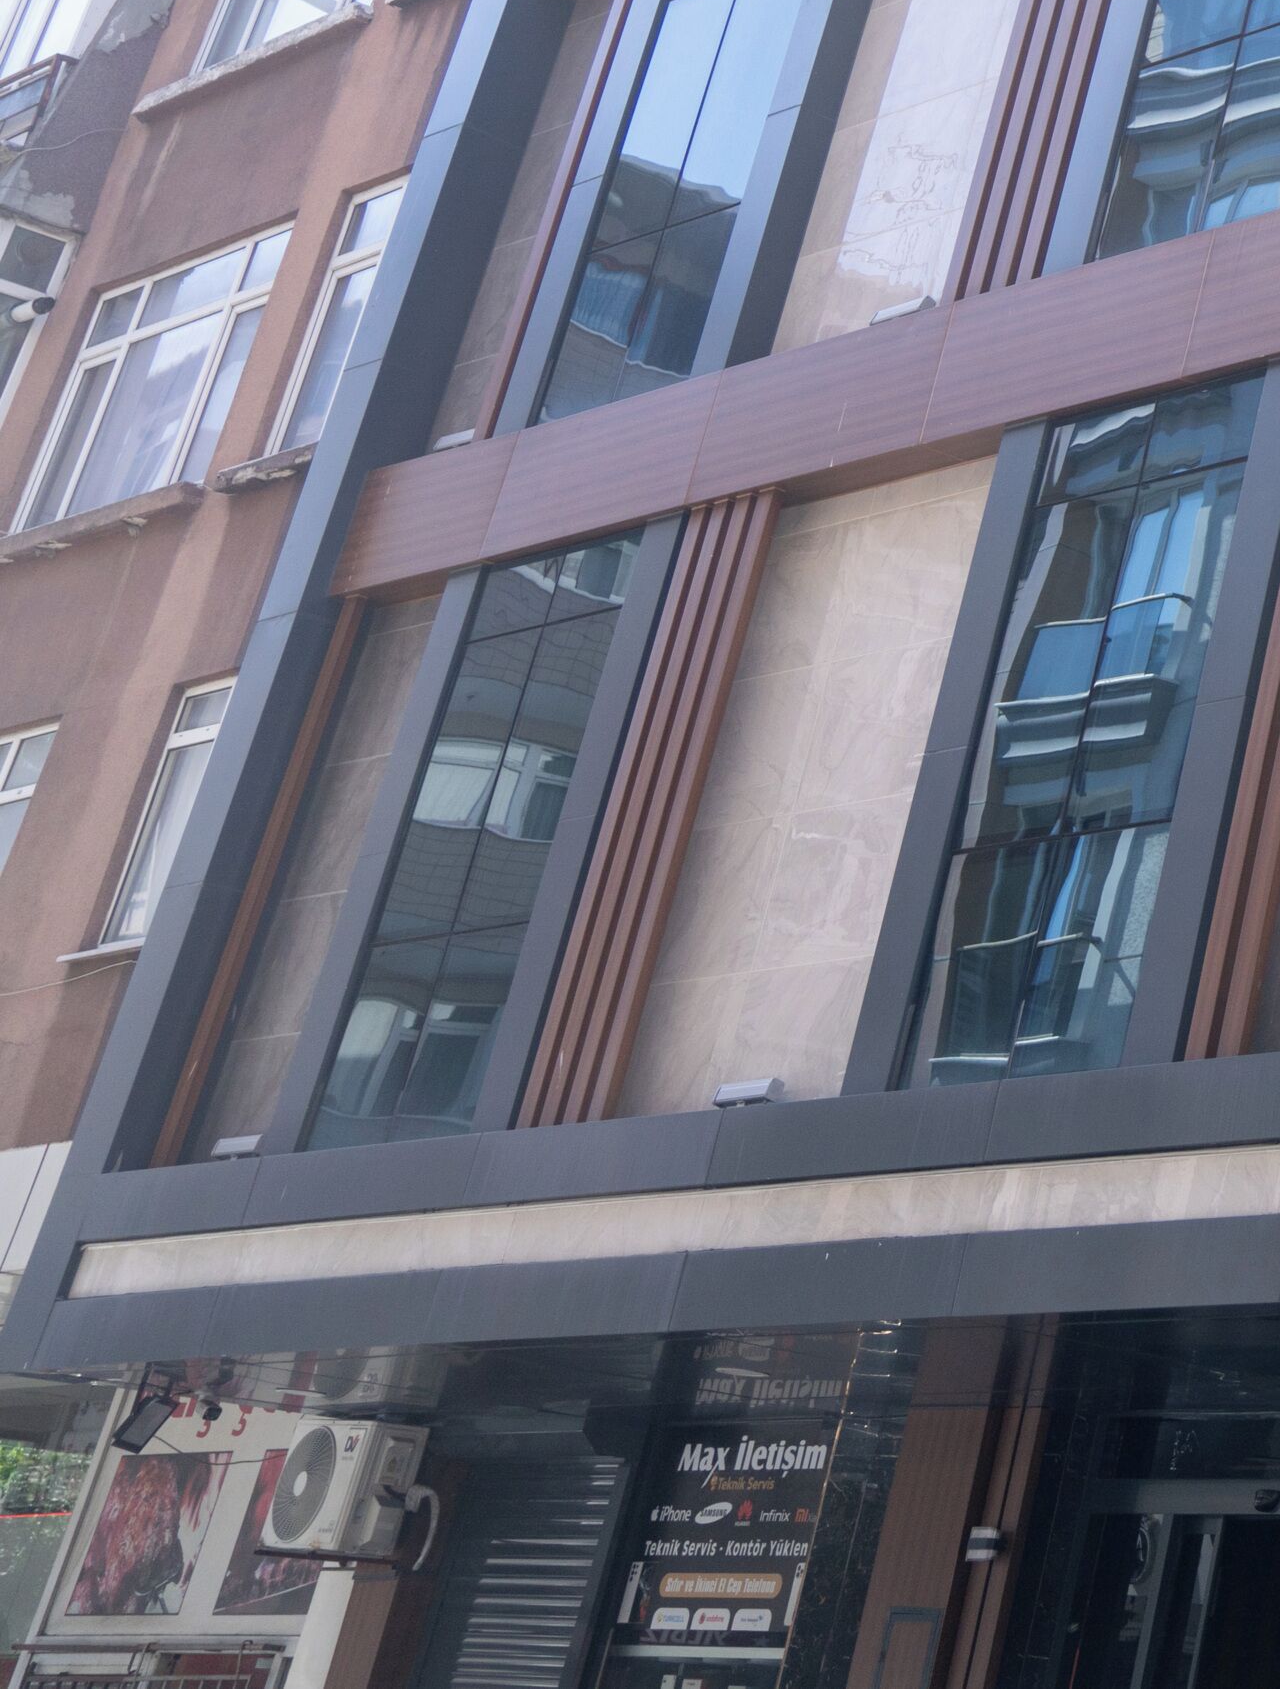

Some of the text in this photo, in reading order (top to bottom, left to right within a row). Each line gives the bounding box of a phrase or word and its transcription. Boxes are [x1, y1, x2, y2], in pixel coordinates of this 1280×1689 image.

[677, 1435, 828, 1489] Max İletişim
[718, 1477, 775, 1491] Teknik Servis
[659, 1505, 692, 1522] iPhone
[644, 1540, 679, 1557] Teknik
[681, 1539, 718, 1557] Servis
[725, 1539, 767, 1557] Kontör
